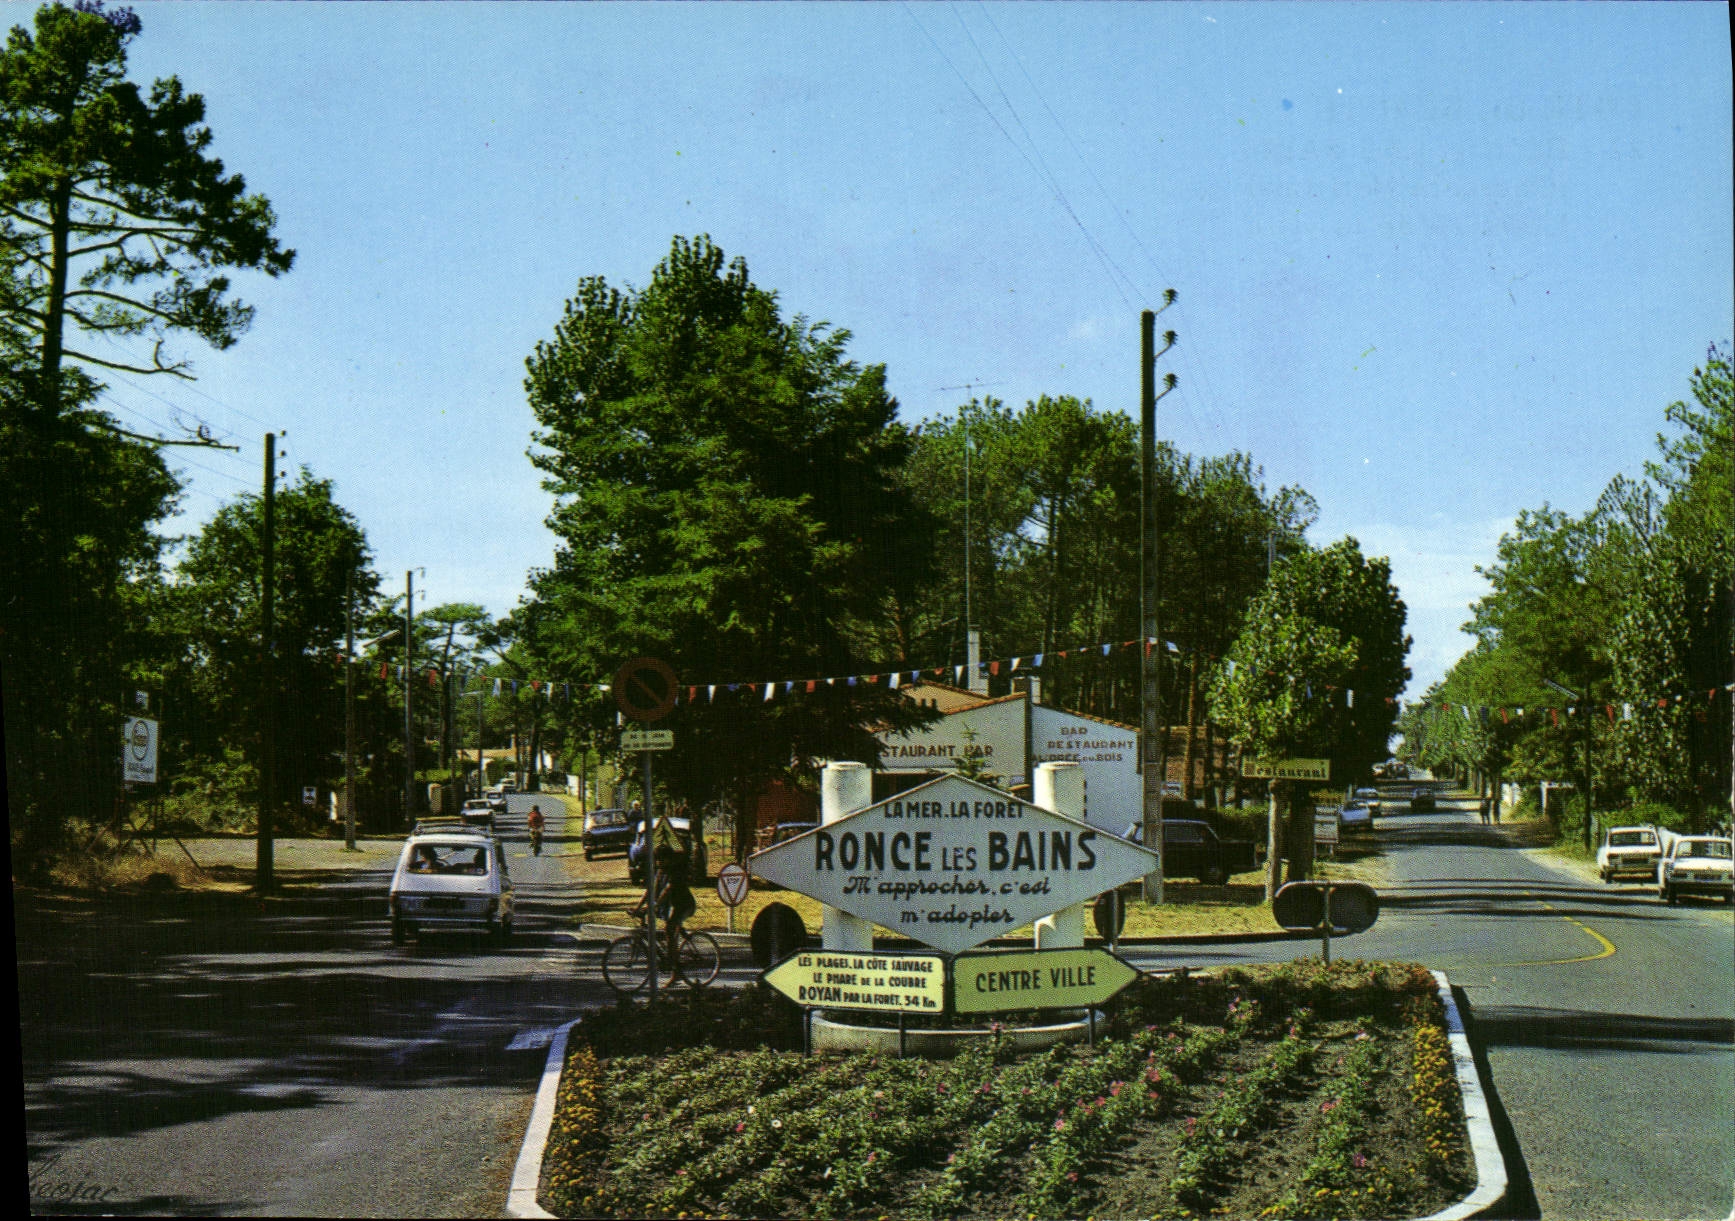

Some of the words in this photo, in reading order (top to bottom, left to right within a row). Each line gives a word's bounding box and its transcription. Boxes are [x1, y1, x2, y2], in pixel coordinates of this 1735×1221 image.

[1047, 741, 1134, 749] RESTAURANT
[974, 801, 1024, 818] FORET
[815, 832, 931, 871] RONCE
[942, 847, 977, 871] LES
[988, 831, 1096, 871] BAINS
[798, 957, 811, 966] LES
[853, 958, 864, 969] LA
[891, 960, 933, 972] SAUVAGE
[813, 972, 823, 983] LE
[826, 973, 857, 985] PHARE
[861, 977, 871, 986] DE
[874, 978, 885, 987] LA
[888, 976, 926, 989] COUBRE
[976, 969, 1041, 993] CENTRE
[1051, 965, 1096, 988] VILLE
[798, 985, 842, 1002] ROYAN
[843, 992, 860, 1002] PAR
[861, 993, 872, 1004] LA
[904, 994, 920, 1007] 34
